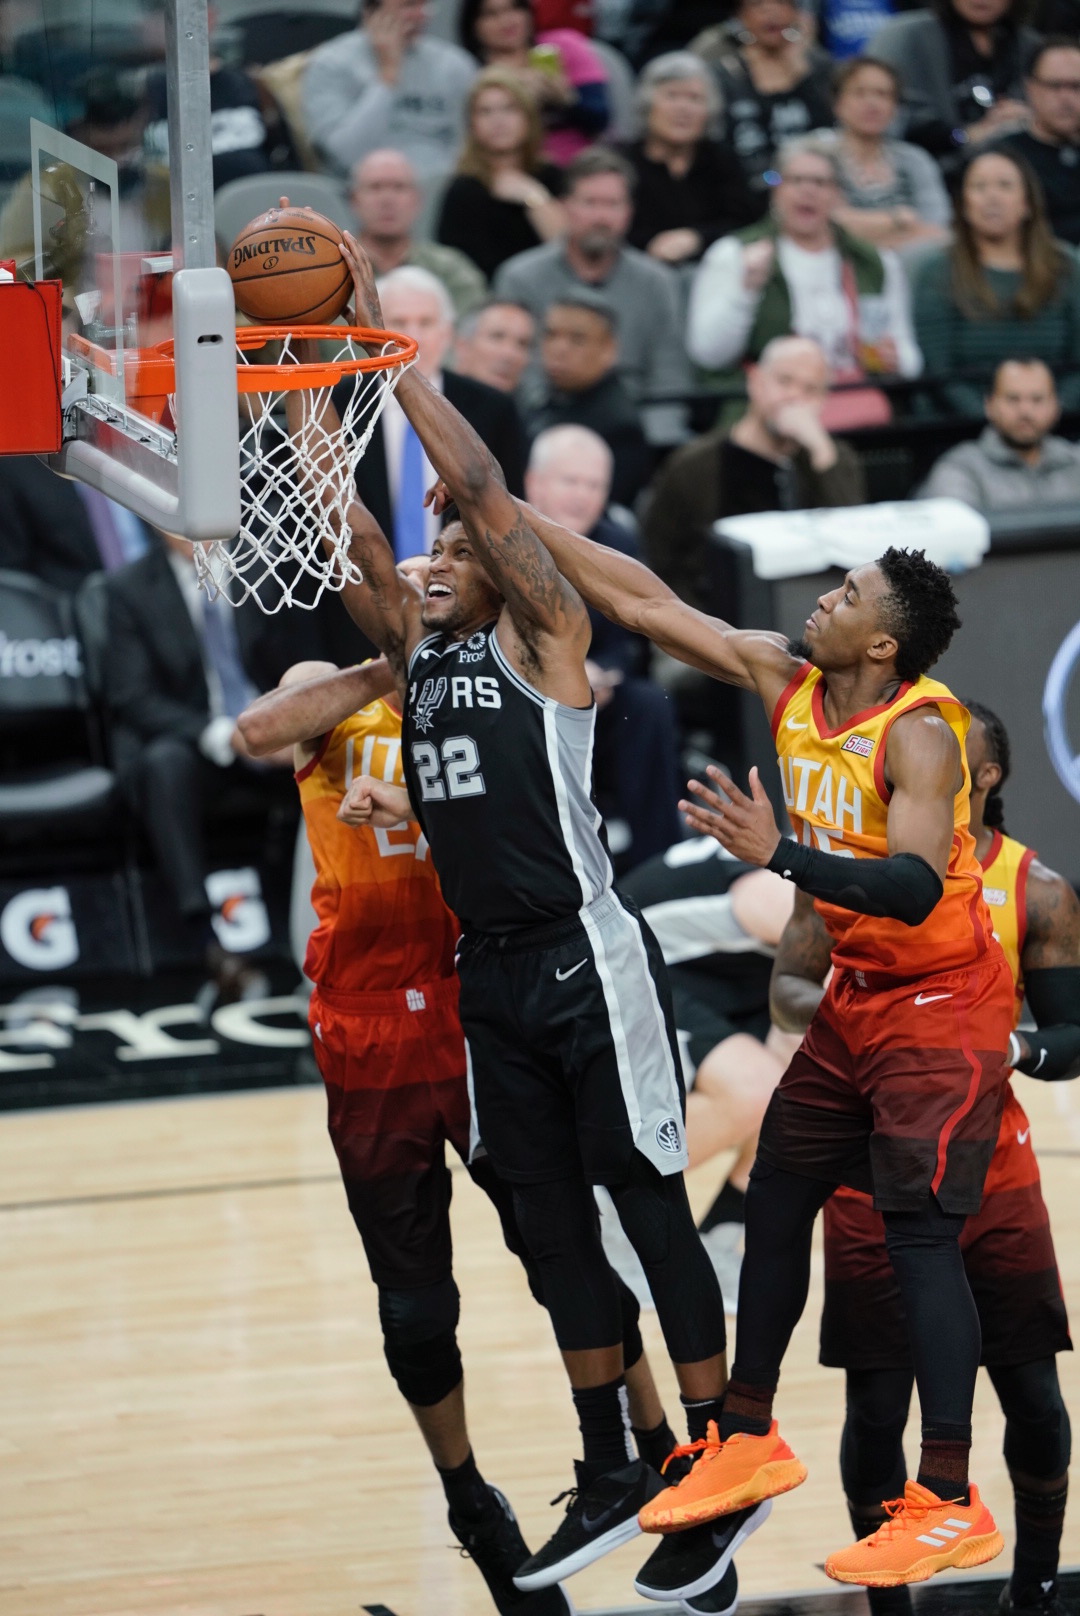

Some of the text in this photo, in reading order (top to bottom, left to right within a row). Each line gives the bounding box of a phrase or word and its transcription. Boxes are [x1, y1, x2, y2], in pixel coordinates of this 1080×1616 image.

[234, 236, 316, 269] SPALDING
[411, 735, 487, 802] 22
[845, 736, 859, 750] 5
[779, 756, 863, 835] UTAH
[1, 885, 80, 971] G
